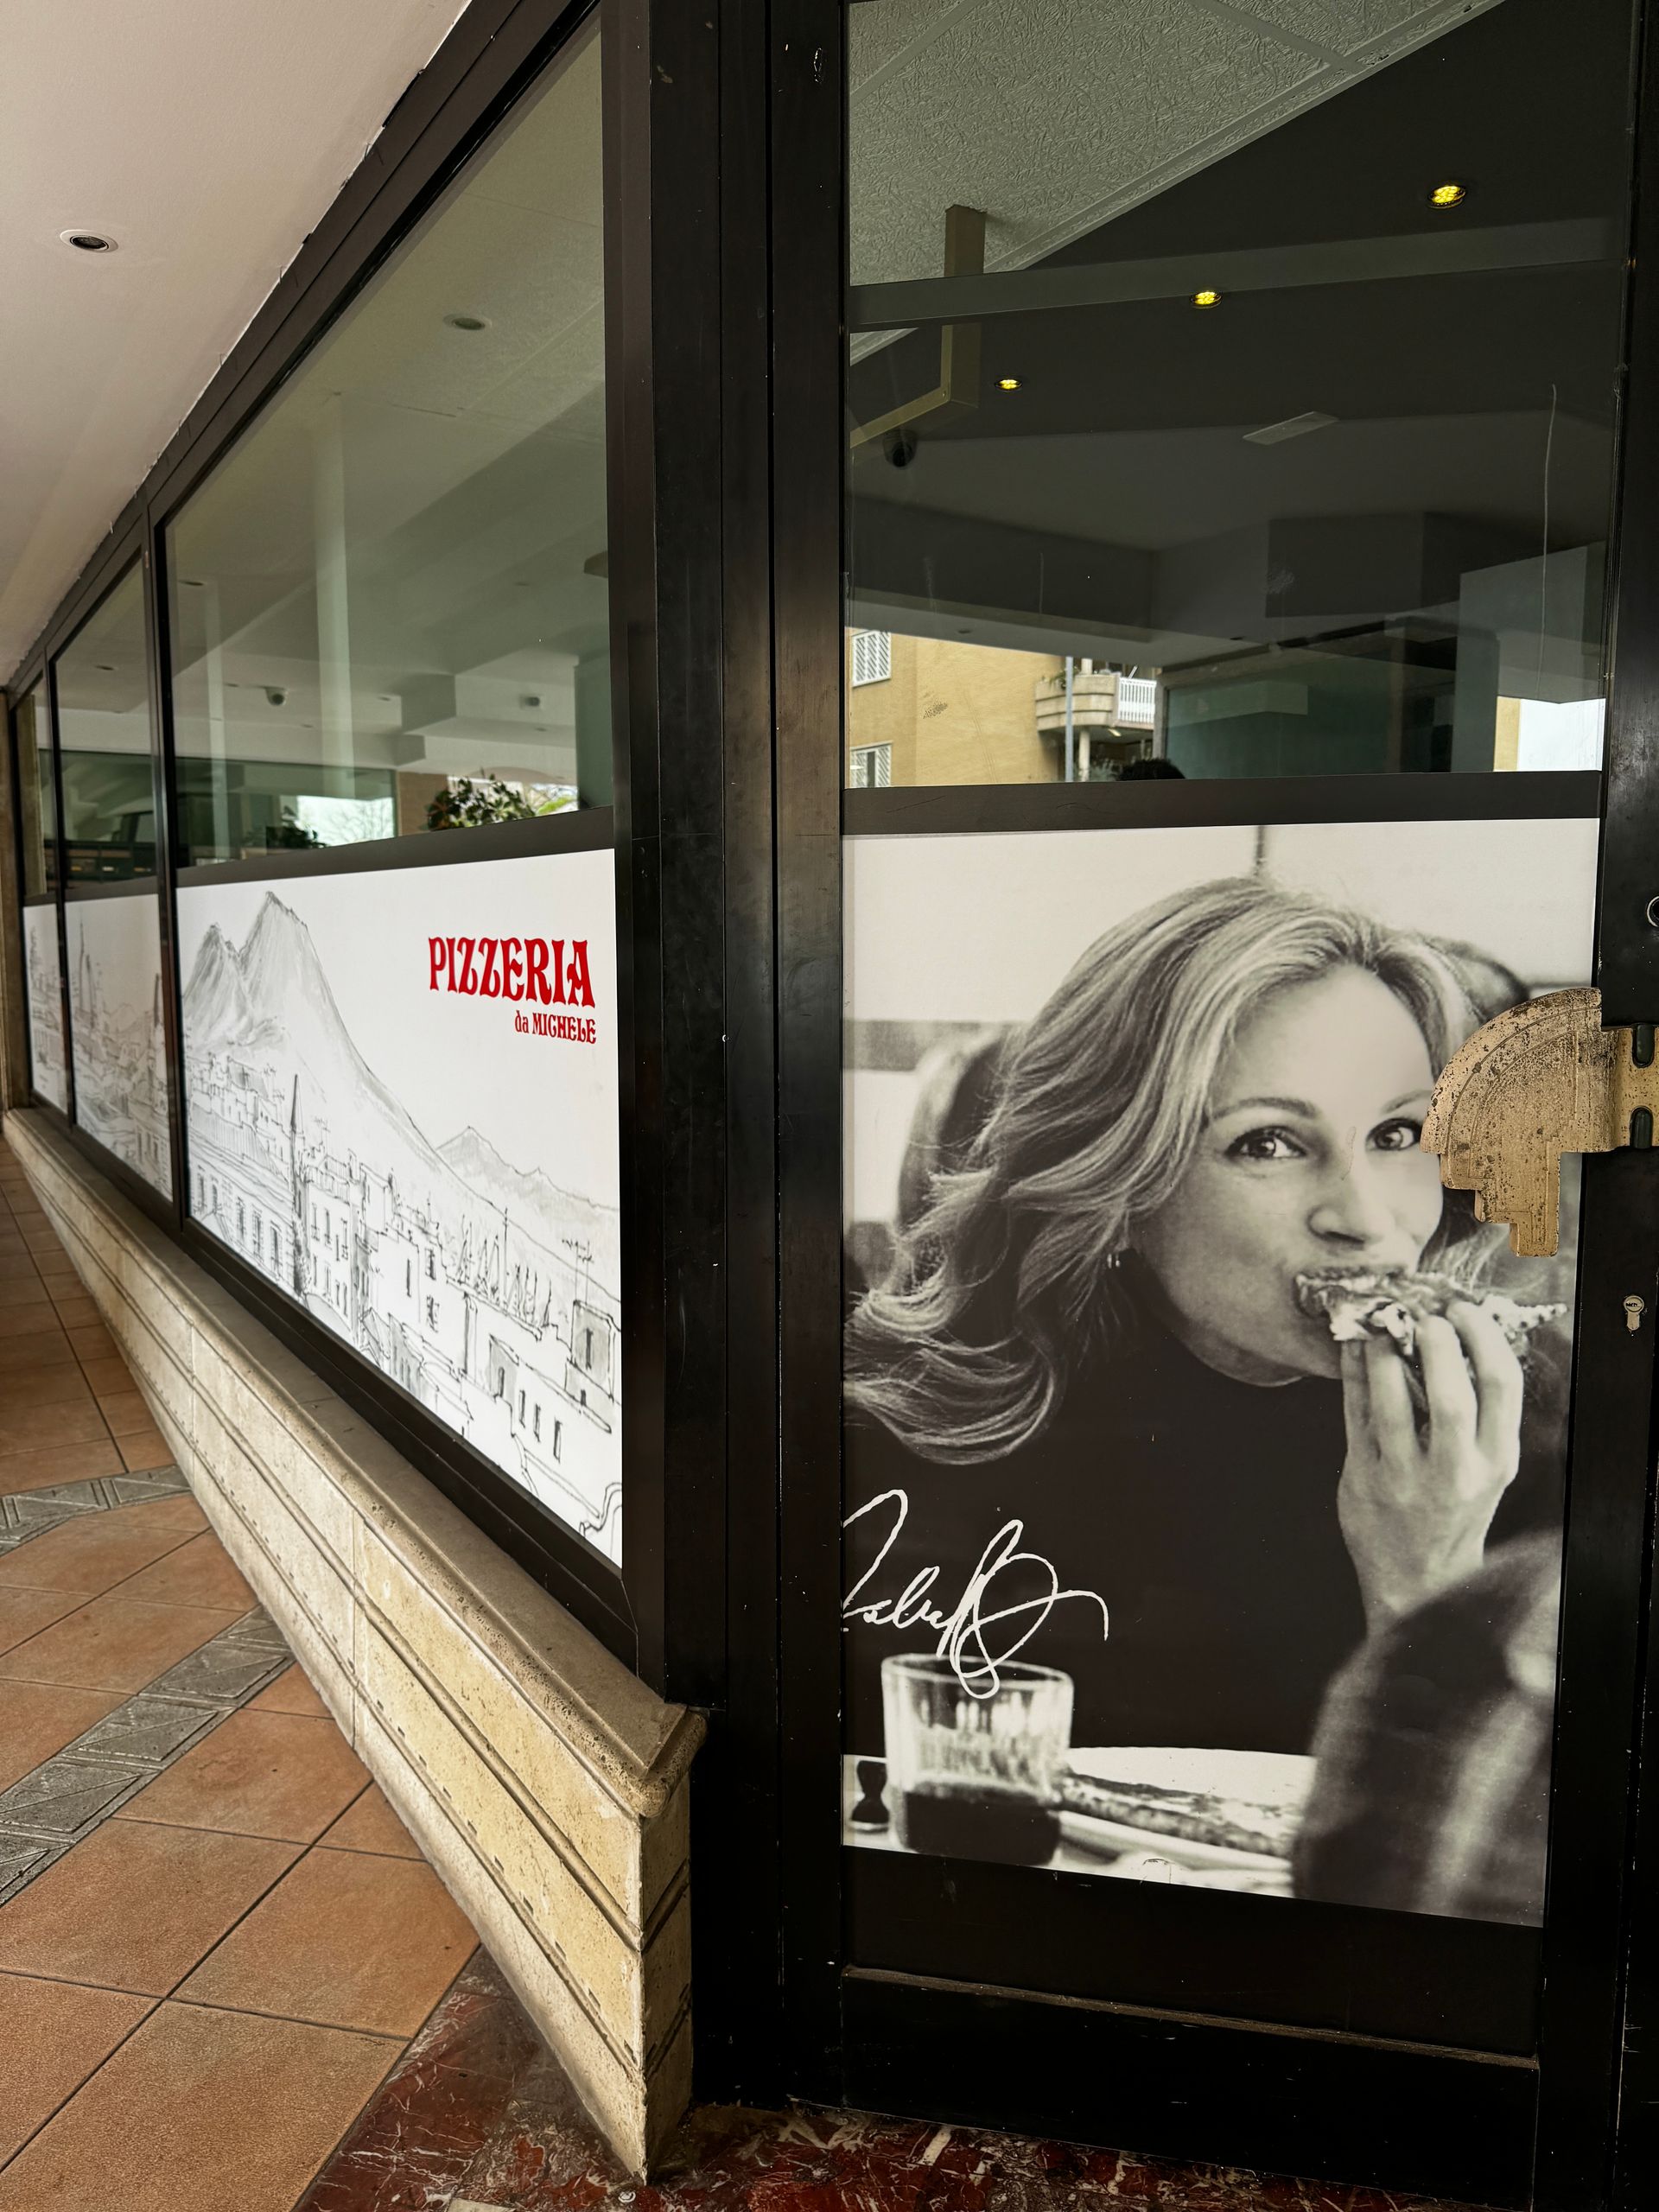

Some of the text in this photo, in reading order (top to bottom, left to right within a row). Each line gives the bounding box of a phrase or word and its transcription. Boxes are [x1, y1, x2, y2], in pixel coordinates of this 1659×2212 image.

[428, 937, 595, 1008] PIZZERIA
[515, 1010, 596, 1045] da MICHELE
